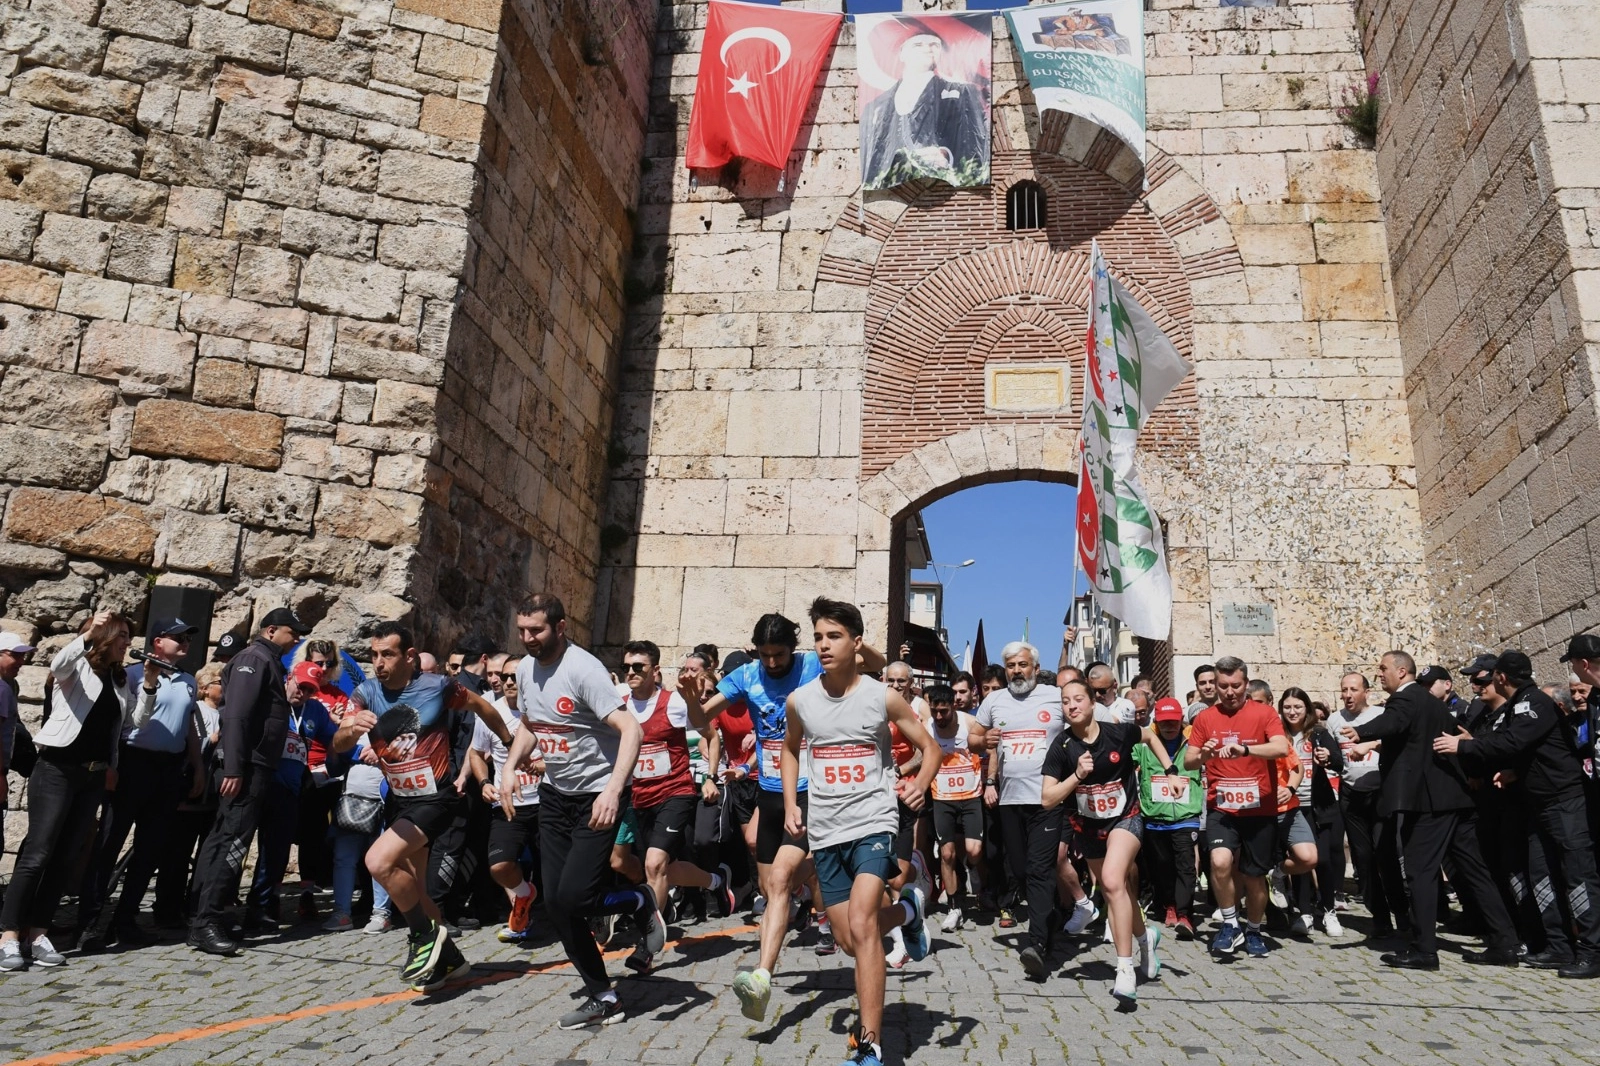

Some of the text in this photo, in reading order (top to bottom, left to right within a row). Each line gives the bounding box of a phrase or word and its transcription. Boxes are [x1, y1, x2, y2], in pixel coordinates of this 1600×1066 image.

[1033, 52, 1088, 62] OSMAN
[1011, 742, 1035, 755] 777
[637, 759, 656, 772] 73
[824, 764, 866, 785] 553
[947, 776, 965, 788] 80
[1087, 796, 1118, 812] 589
